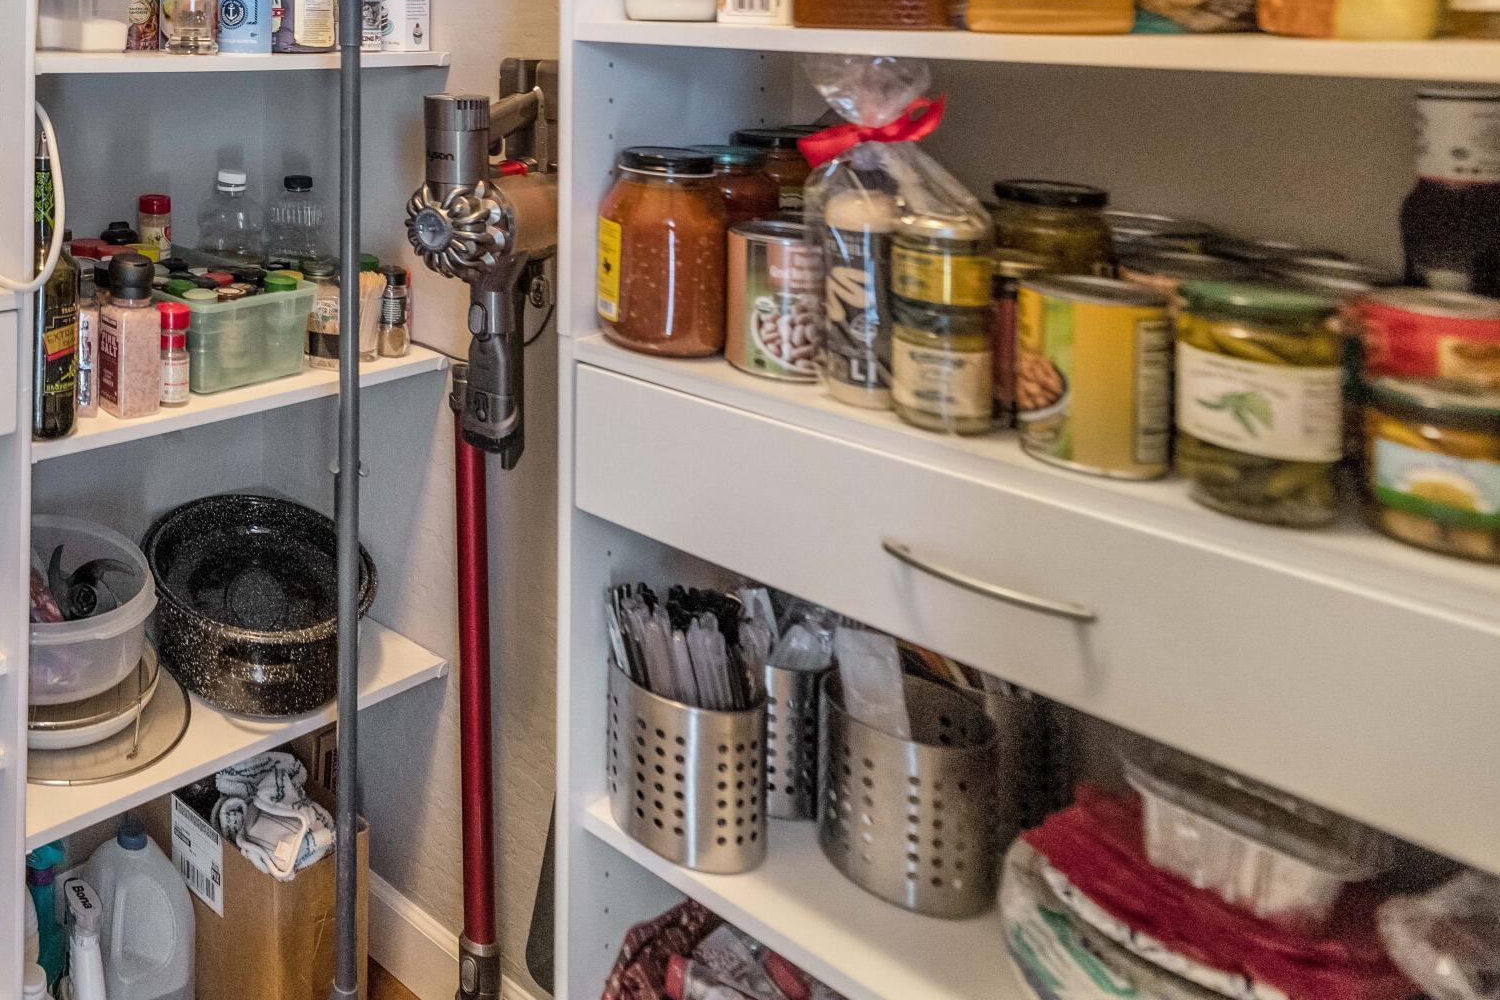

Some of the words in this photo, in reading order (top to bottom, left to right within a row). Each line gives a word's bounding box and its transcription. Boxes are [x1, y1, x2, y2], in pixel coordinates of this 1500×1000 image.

[100, 329, 118, 344] PINK
[100, 342, 118, 358] SALT
[71, 884, 95, 911] Bona
